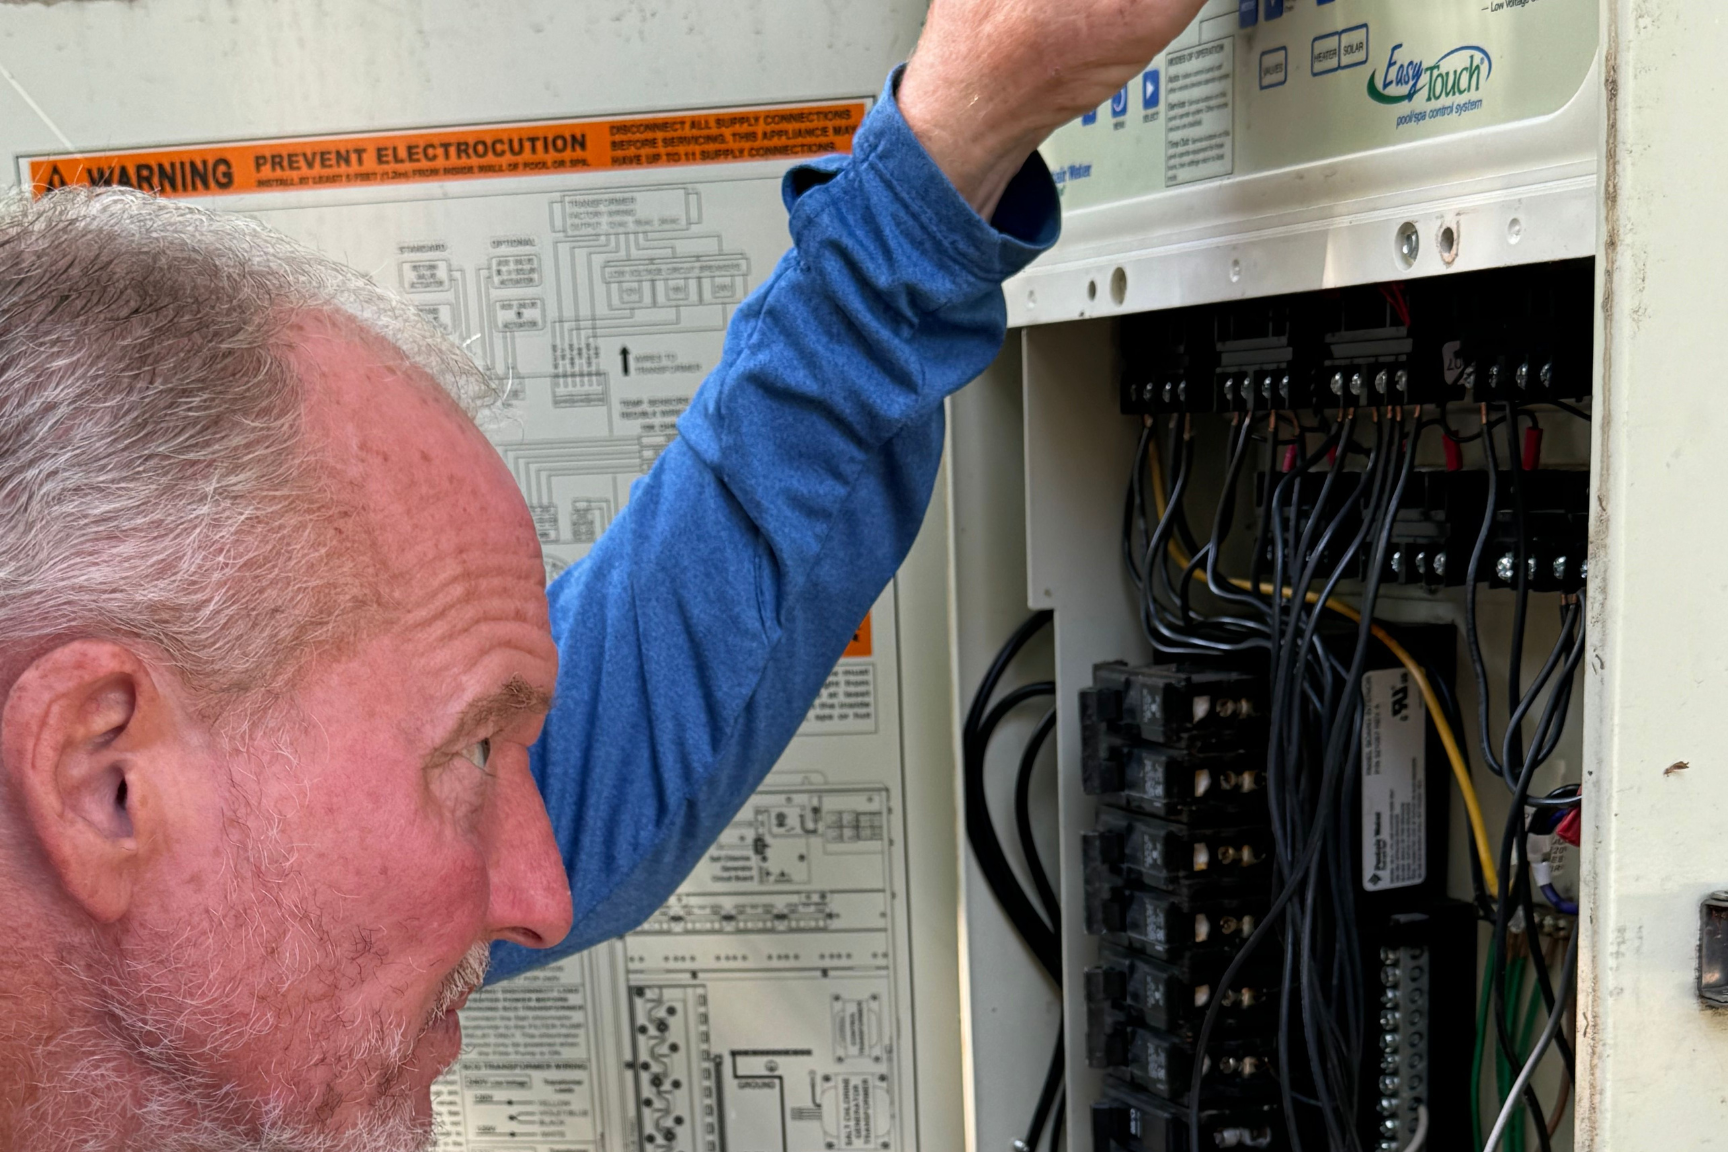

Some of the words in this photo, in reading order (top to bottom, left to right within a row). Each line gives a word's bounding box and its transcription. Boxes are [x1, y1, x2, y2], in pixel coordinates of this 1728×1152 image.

[1313, 48, 1338, 64] HEATER
[1343, 41, 1364, 56] SOLAR
[1382, 42, 1424, 103] Easy
[1428, 102, 1454, 119] control
[1455, 99, 1483, 116] system
[610, 121, 686, 136] DISCONNECT
[690, 119, 712, 131] ALL
[715, 115, 760, 129] SUPPLY
[763, 109, 851, 126] CONNECTIONS
[611, 138, 658, 151] BEFORE
[731, 131, 758, 142] THIS
[762, 127, 829, 140] APPLIANCE
[254, 148, 367, 174] PREVENT
[376, 133, 586, 166] ELECTROCUTION
[665, 152, 681, 163] TO
[699, 148, 746, 161] SUPPLY
[86, 158, 234, 193] WARNING
[738, 1081, 776, 1090] GROUND
